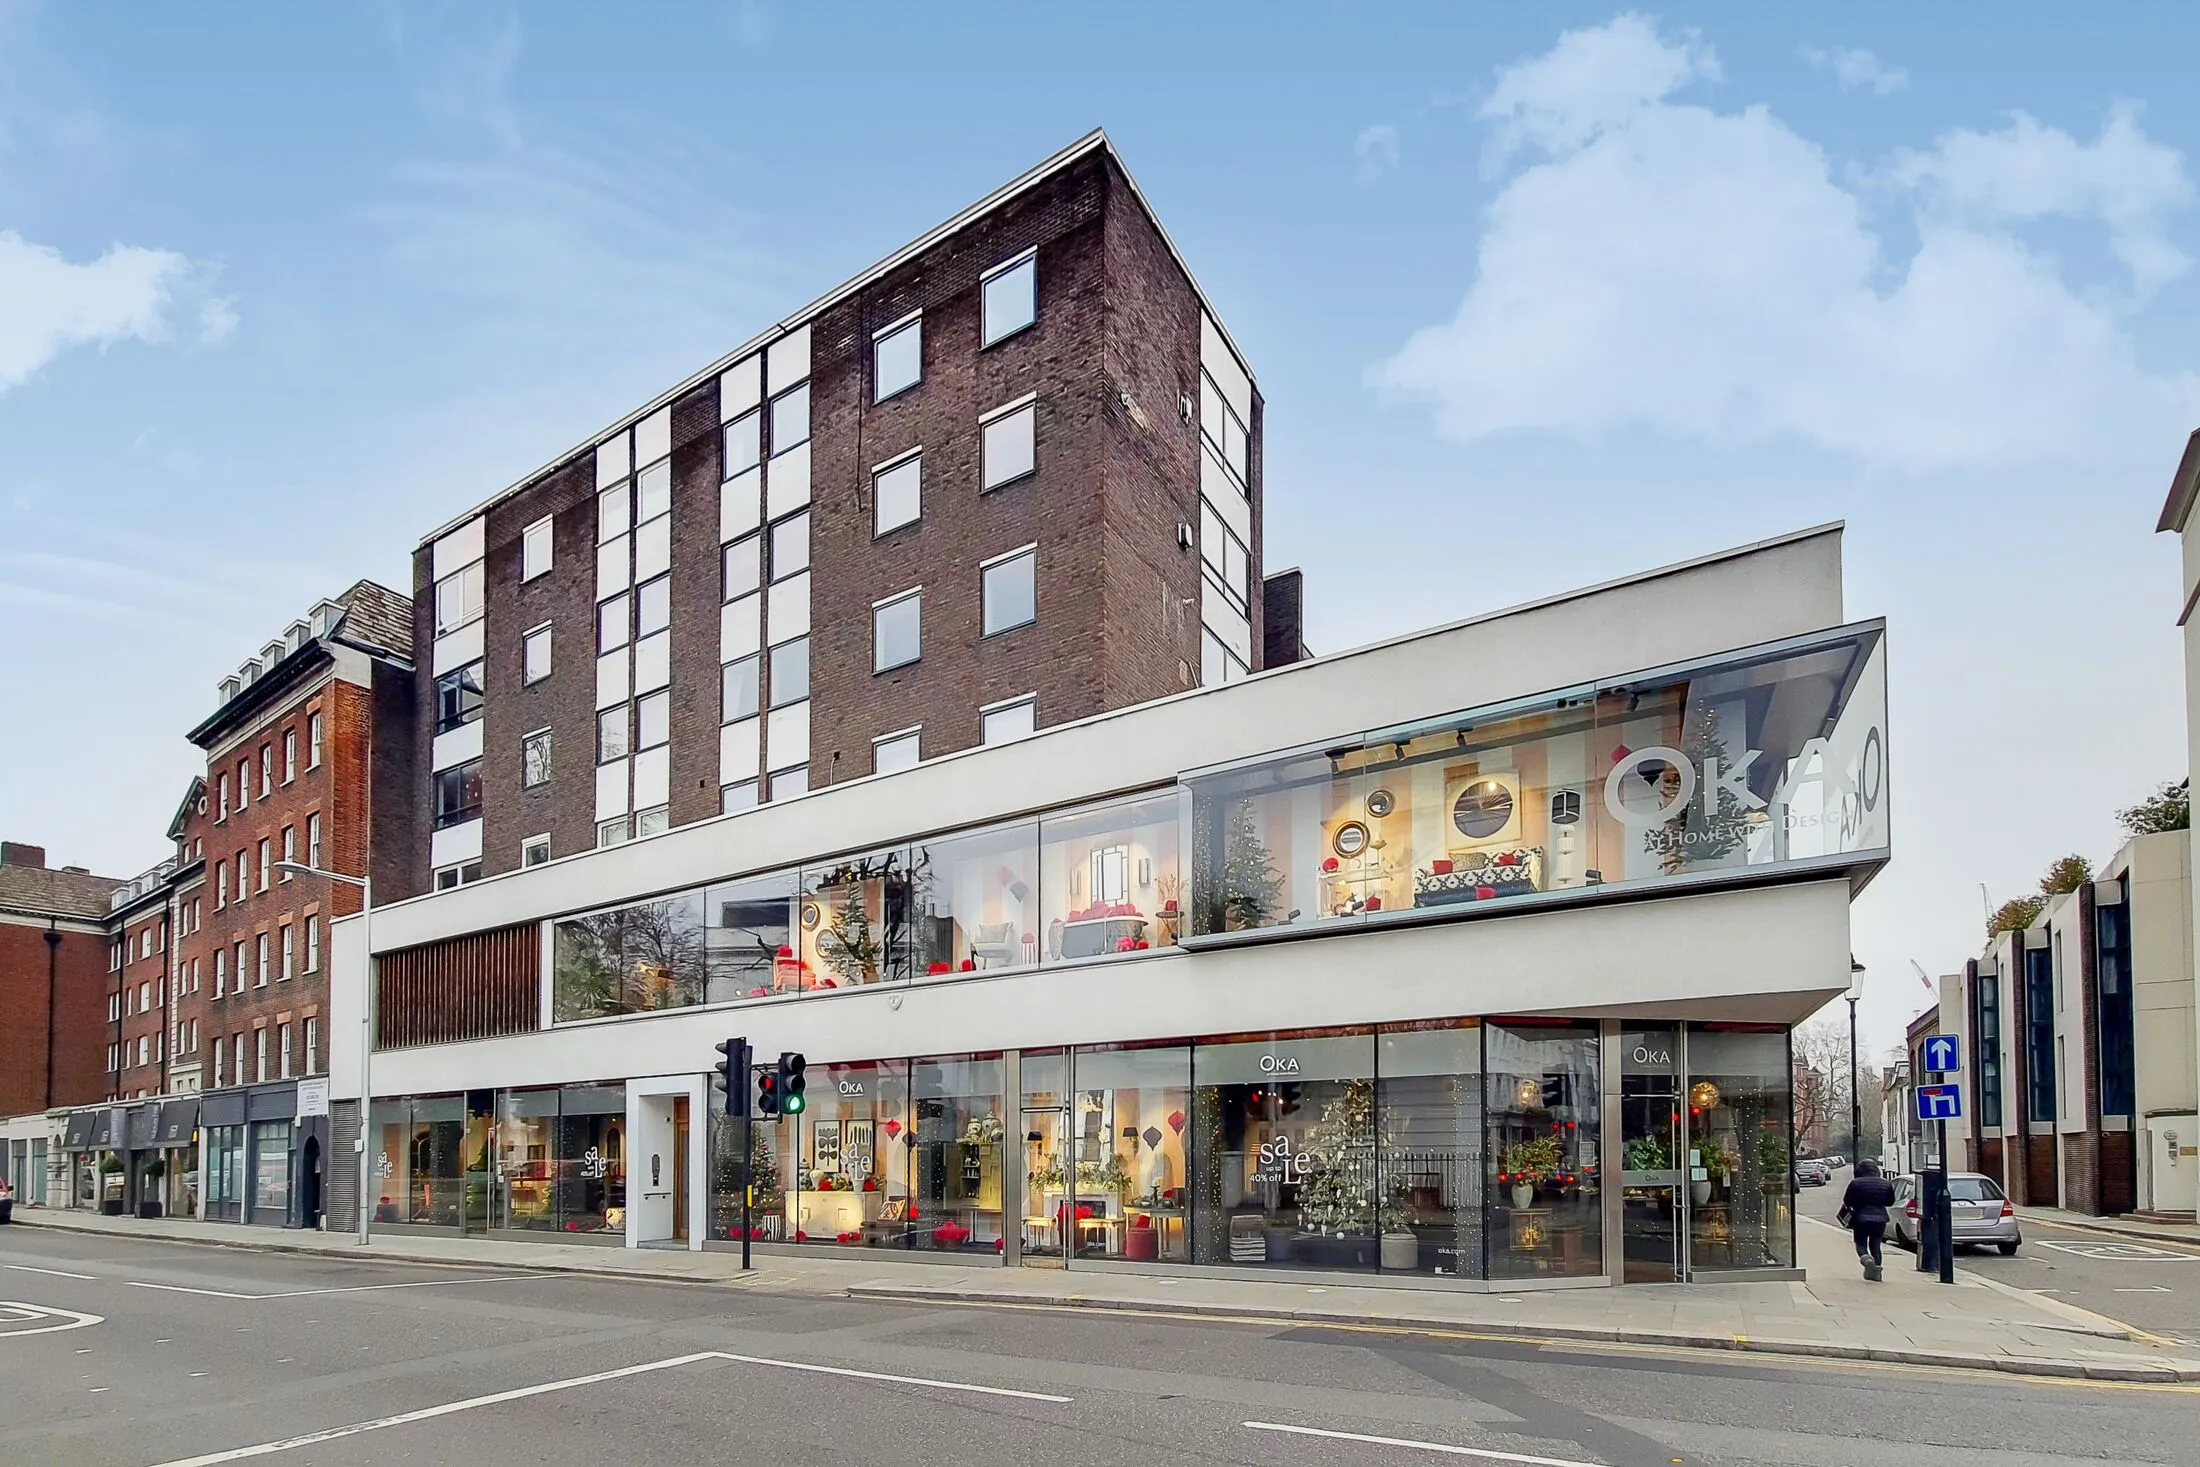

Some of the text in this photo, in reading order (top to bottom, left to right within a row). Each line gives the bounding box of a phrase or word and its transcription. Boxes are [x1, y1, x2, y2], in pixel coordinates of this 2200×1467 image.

[1603, 736, 1857, 828] OKA
[1669, 828, 1724, 847] HOME
[1633, 1046, 1671, 1063] OKA
[1260, 1055, 1300, 1071] OKA
[839, 1081, 864, 1093] OKA
[1249, 1173, 1282, 1182] 40% off
[1437, 1246, 1466, 1254] oka.com
